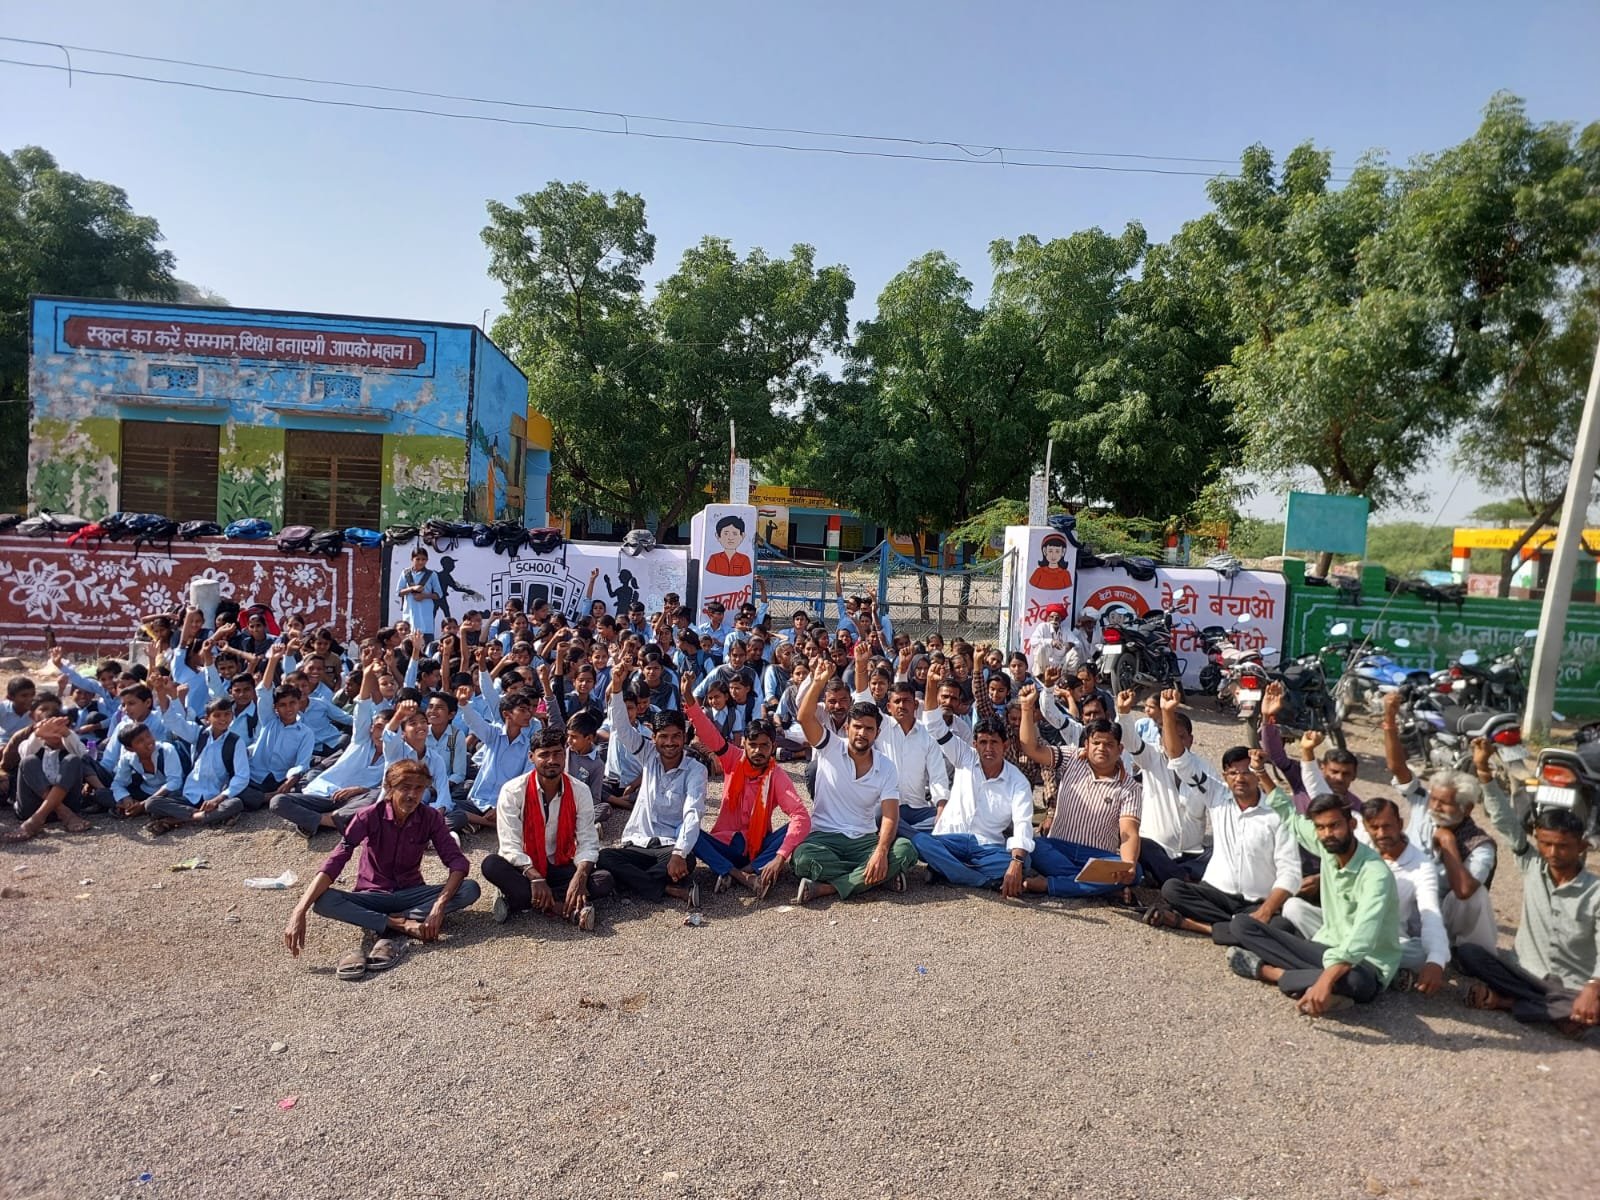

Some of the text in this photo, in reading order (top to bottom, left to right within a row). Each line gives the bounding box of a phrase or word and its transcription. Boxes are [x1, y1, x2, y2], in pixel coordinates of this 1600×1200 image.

[87, 325, 128, 348] स्कूल
[131, 329, 152, 346] का
[154, 324, 182, 348] करें
[239, 330, 273, 356] शिक्षा
[329, 337, 371, 359] आपको
[515, 562, 559, 576] SCHOOL
[1208, 589, 1276, 620] बचाओ
